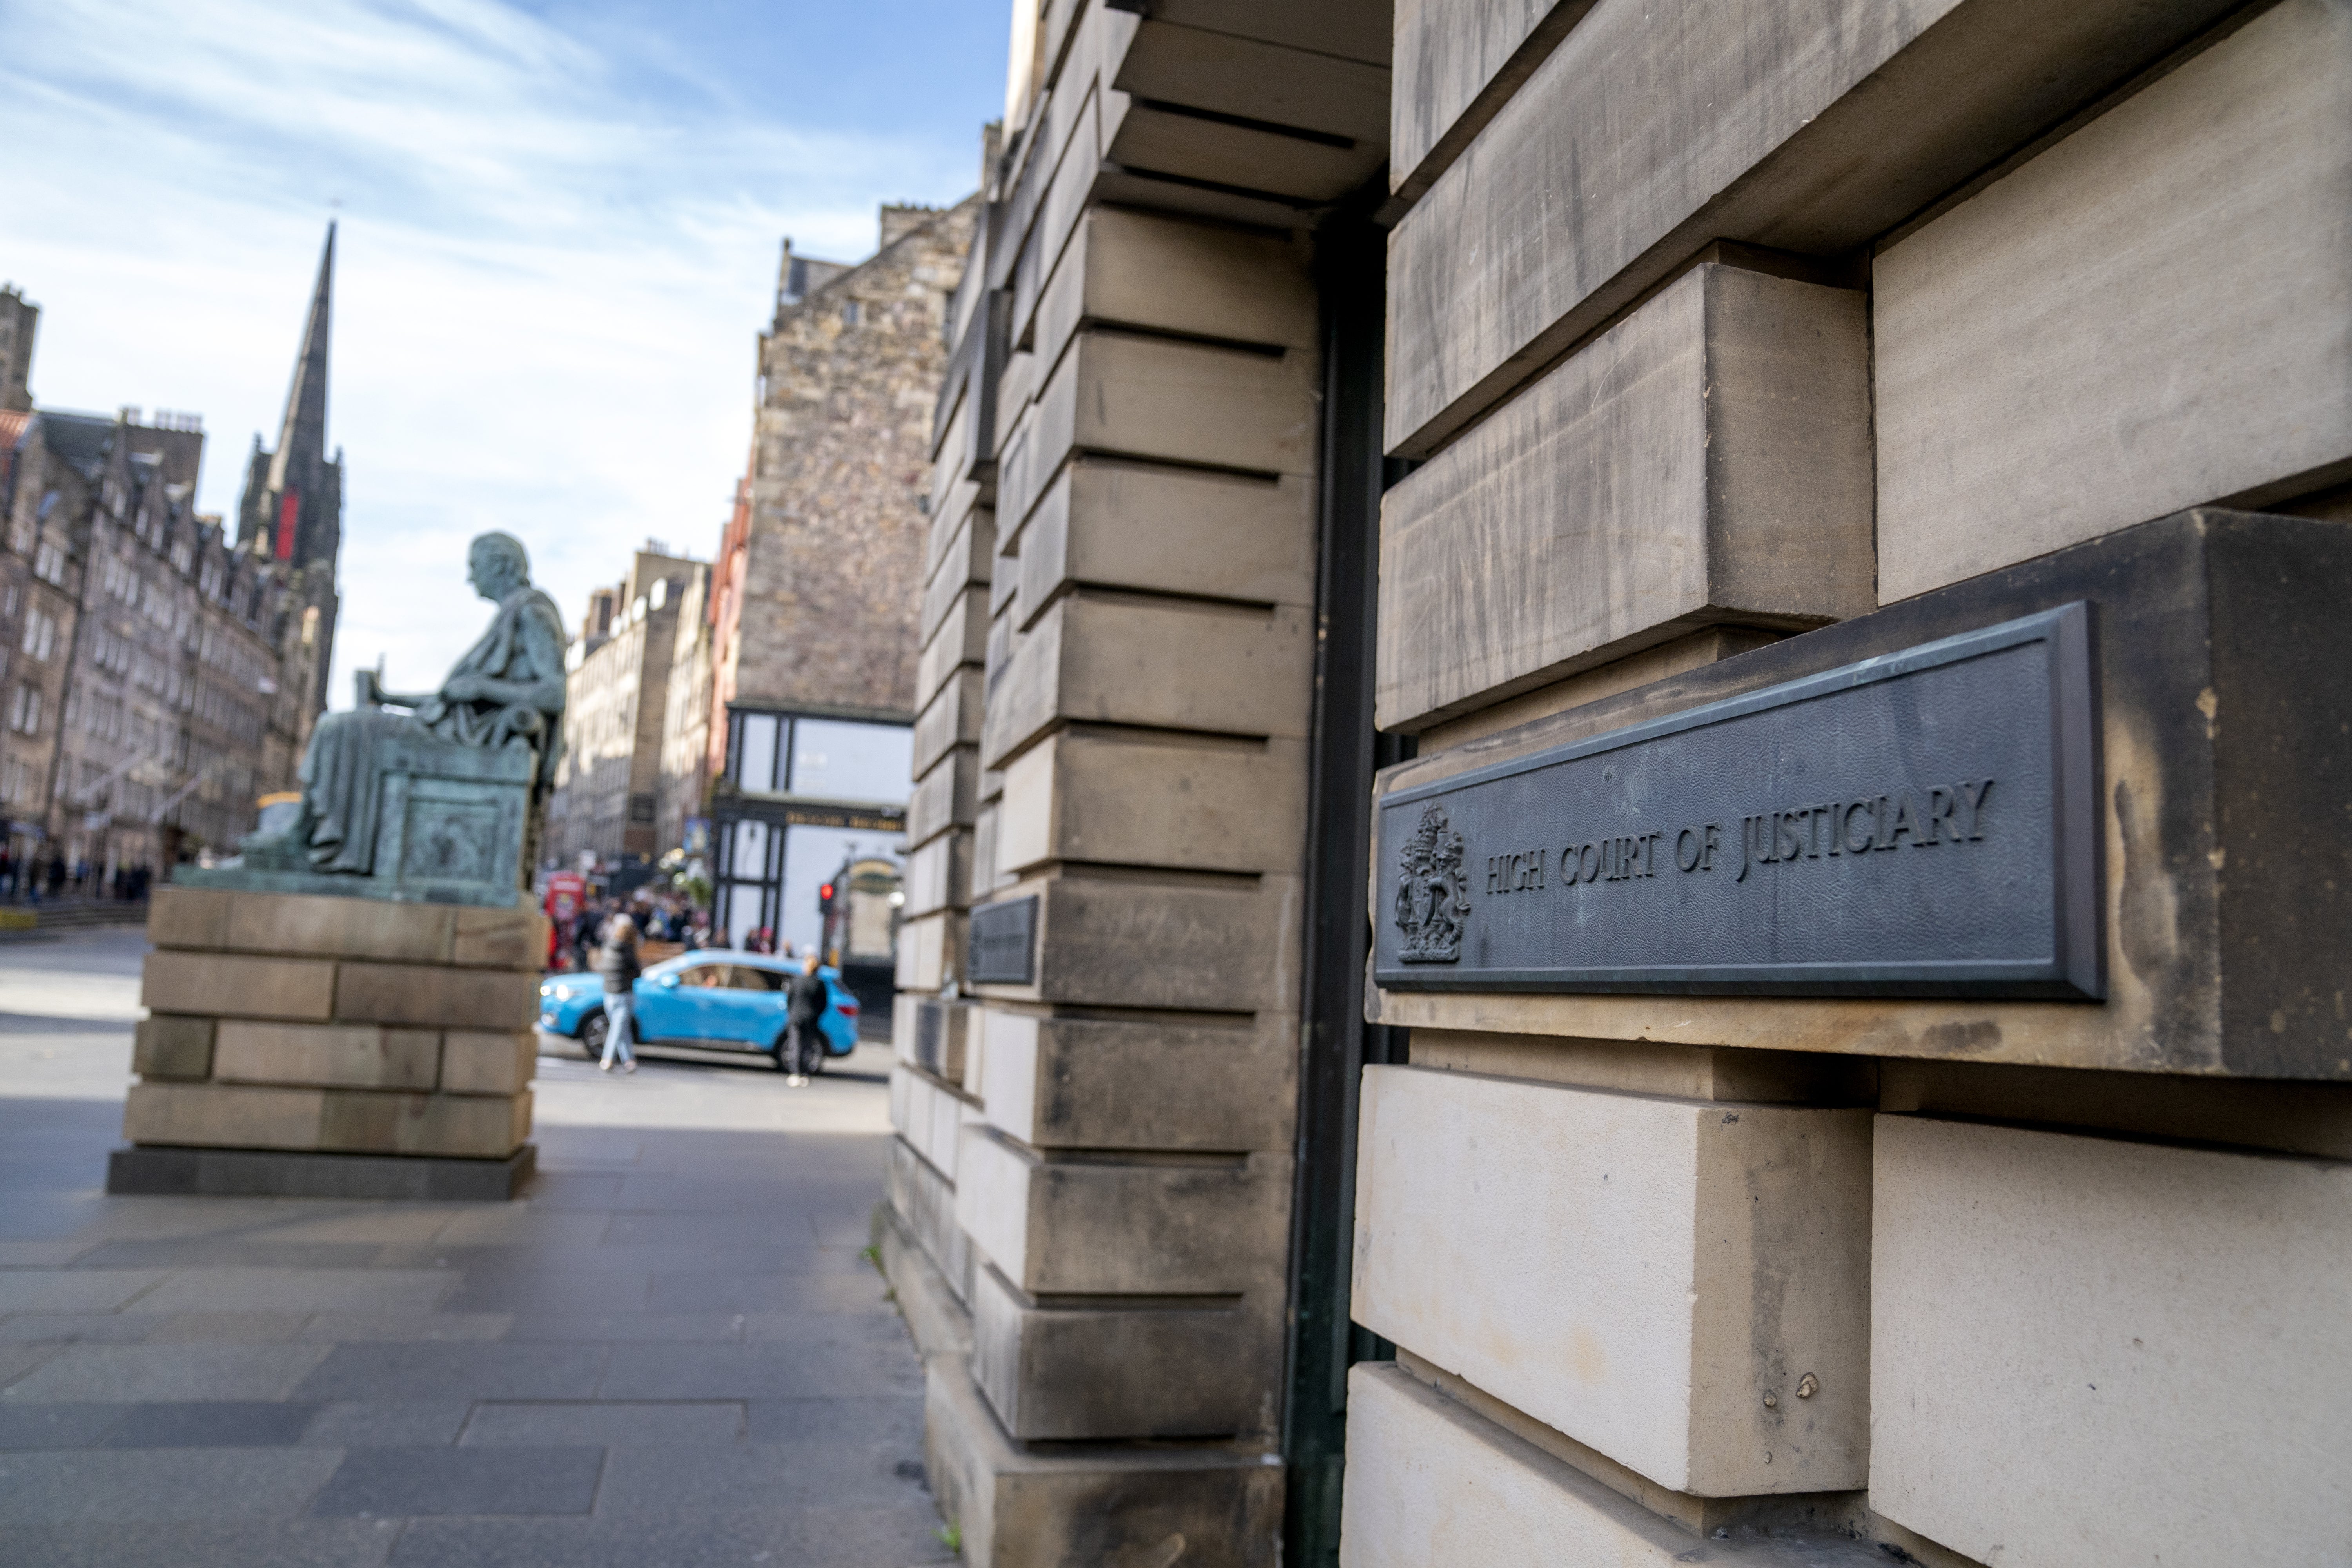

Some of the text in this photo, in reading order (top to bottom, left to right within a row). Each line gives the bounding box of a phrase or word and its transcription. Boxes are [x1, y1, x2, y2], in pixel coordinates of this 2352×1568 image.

[1486, 777, 1994, 894] HIGH COURT OF JUSTICIARY
